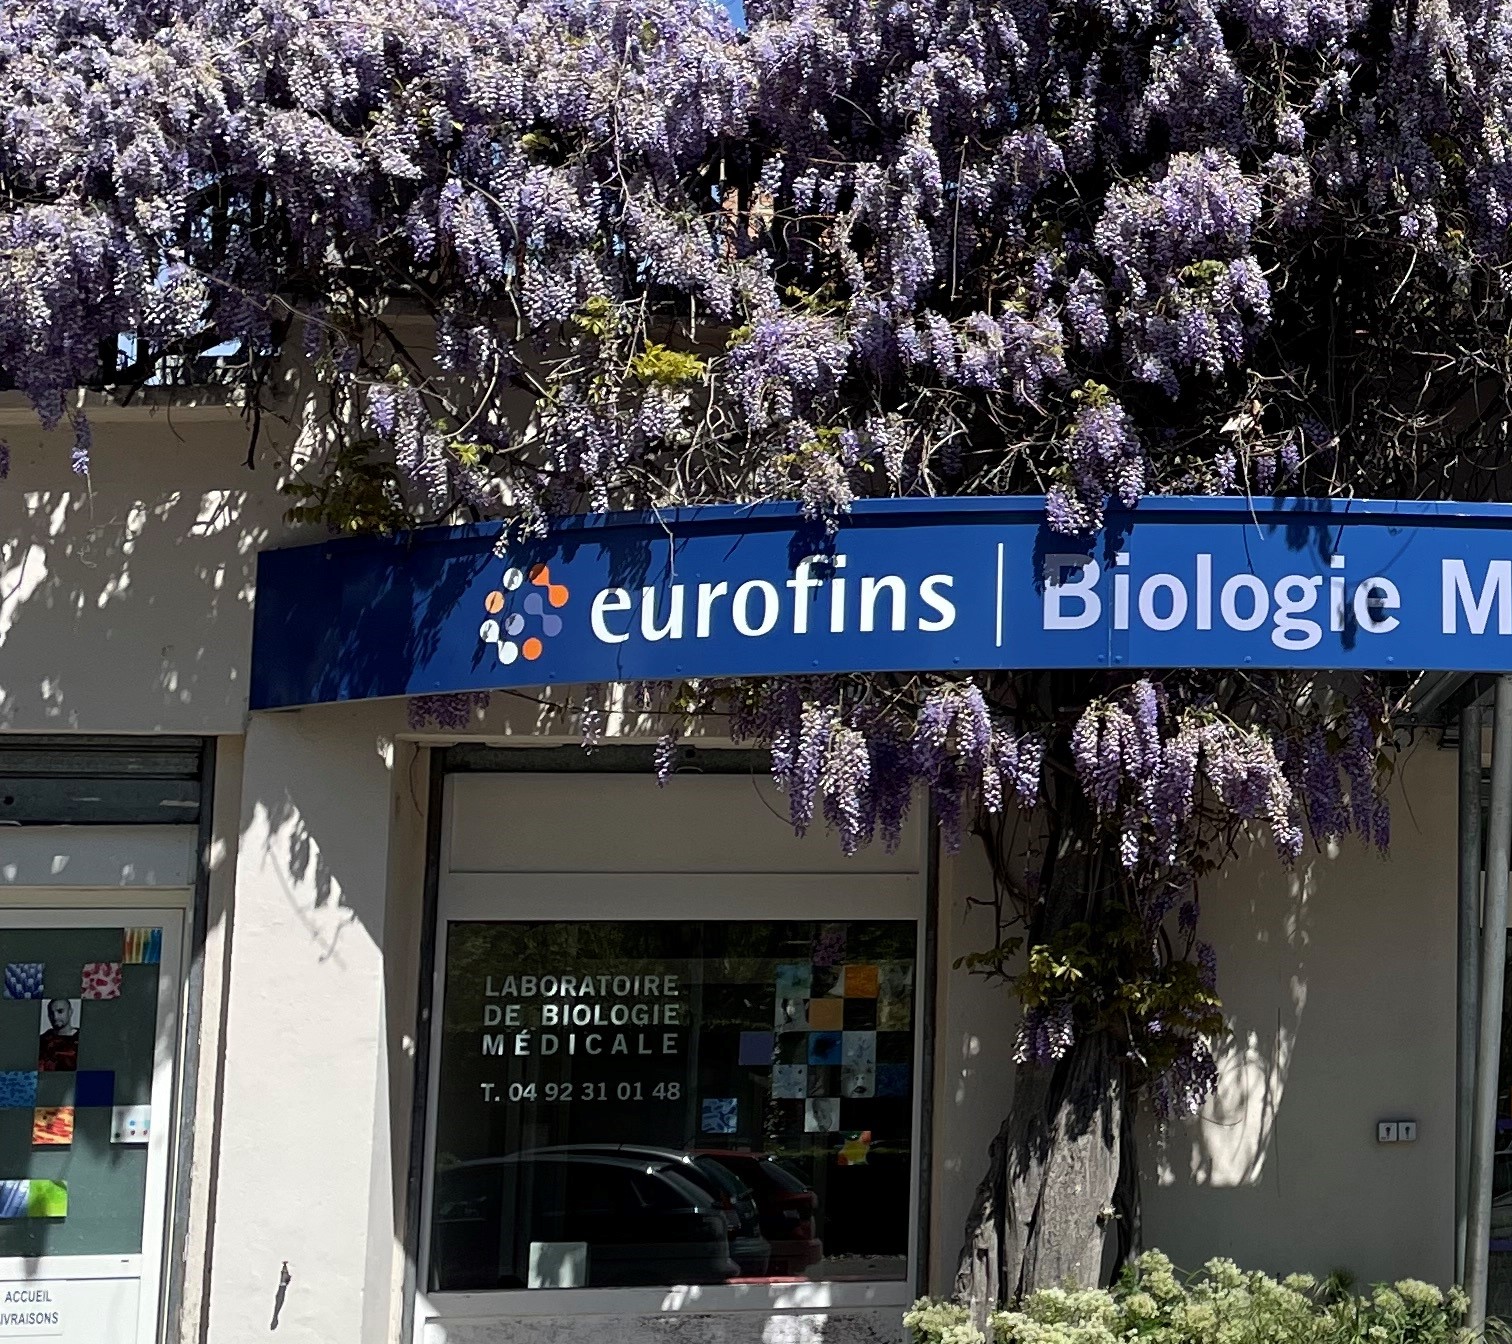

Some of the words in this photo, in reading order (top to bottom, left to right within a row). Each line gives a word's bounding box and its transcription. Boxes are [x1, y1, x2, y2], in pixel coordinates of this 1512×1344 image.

[590, 553, 957, 645] eurofins
[1042, 552, 1402, 651] Biologie
[484, 974, 680, 998] LABORATOIRE
[483, 1004, 521, 1027] DE
[541, 1003, 680, 1027] BIOLOGIE
[481, 1028, 680, 1056] MÉDICALE
[480, 1082, 501, 1103] T.
[508, 1082, 538, 1102] 04
[544, 1082, 573, 1102] 92
[580, 1082, 608, 1101] 31
[616, 1082, 643, 1101] 01
[651, 1081, 681, 1101] 48
[4, 1290, 53, 1303] ACCUEIL
[0, 1311, 59, 1326] IVRAISONS
